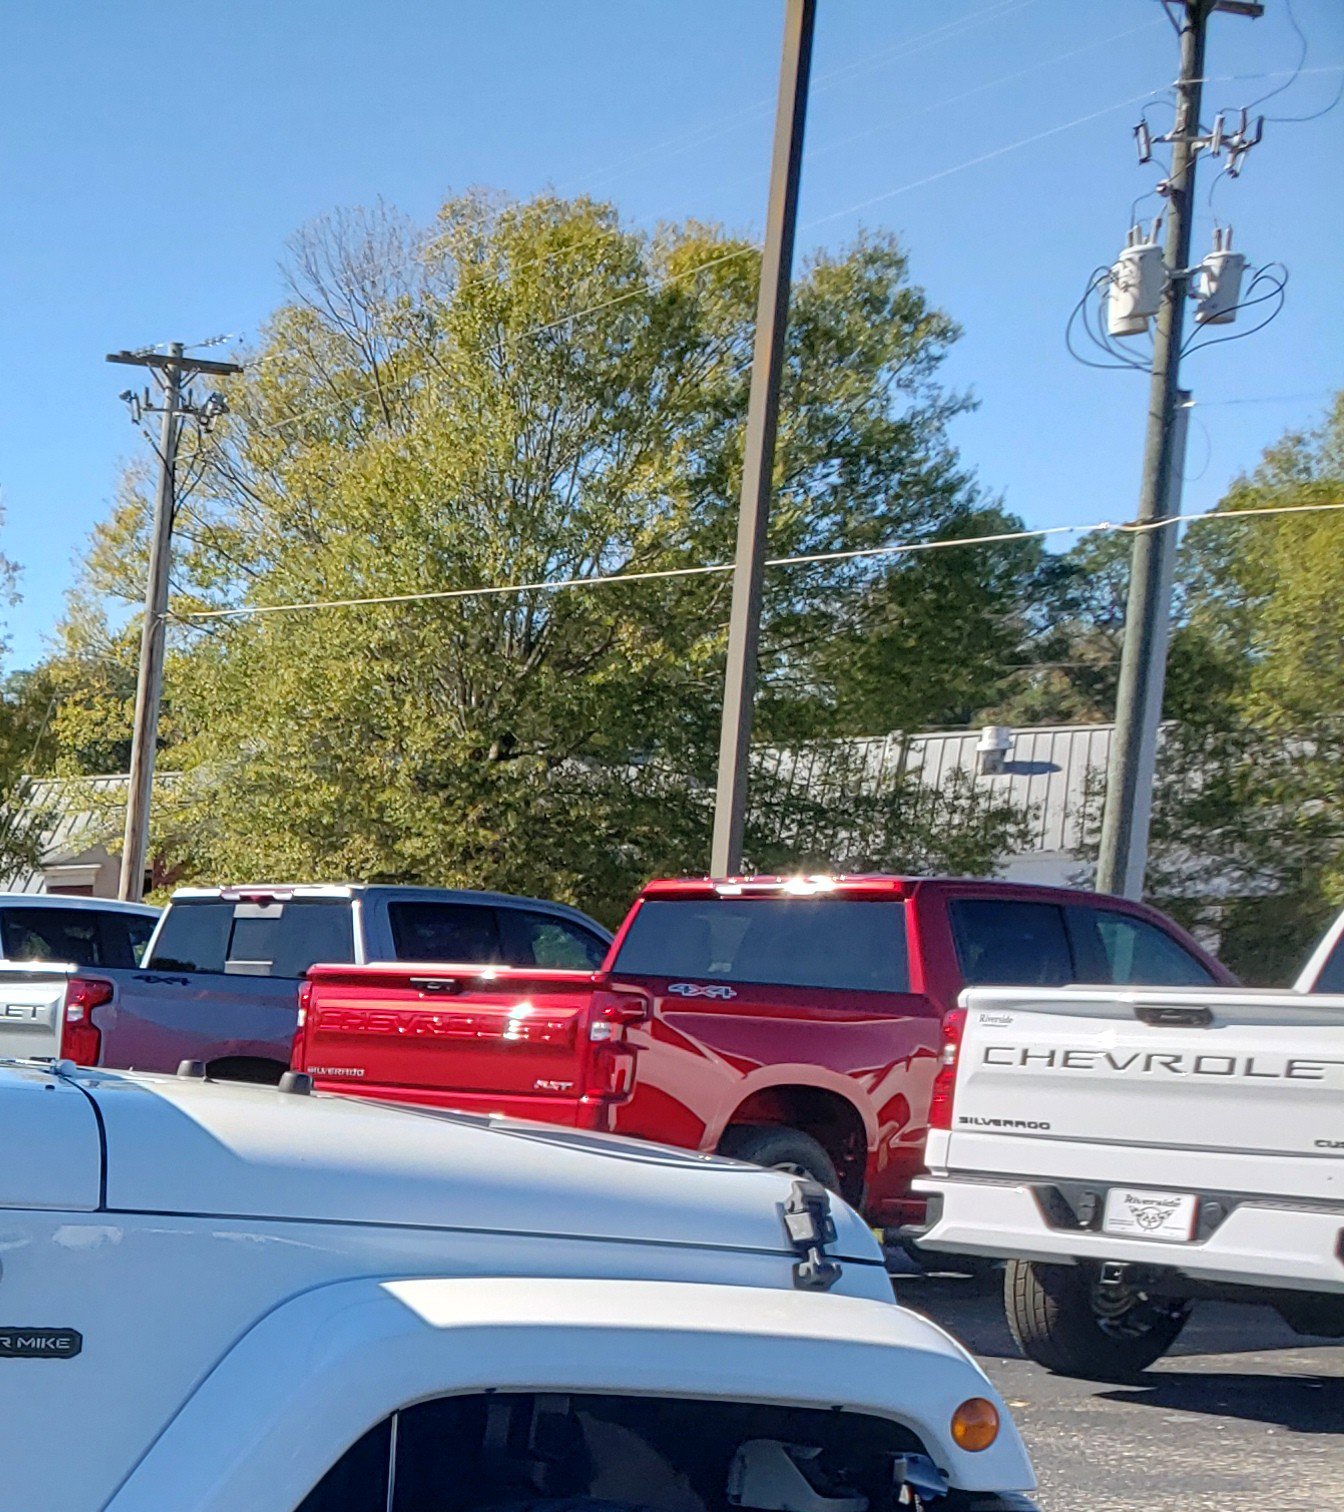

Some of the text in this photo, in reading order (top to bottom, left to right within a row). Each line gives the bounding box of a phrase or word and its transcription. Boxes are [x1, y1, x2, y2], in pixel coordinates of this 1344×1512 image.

[307, 1066, 366, 1077] SILVERADO
[958, 1116, 1051, 1131] SILVERADO
[16, 1336, 71, 1350] MIKE
